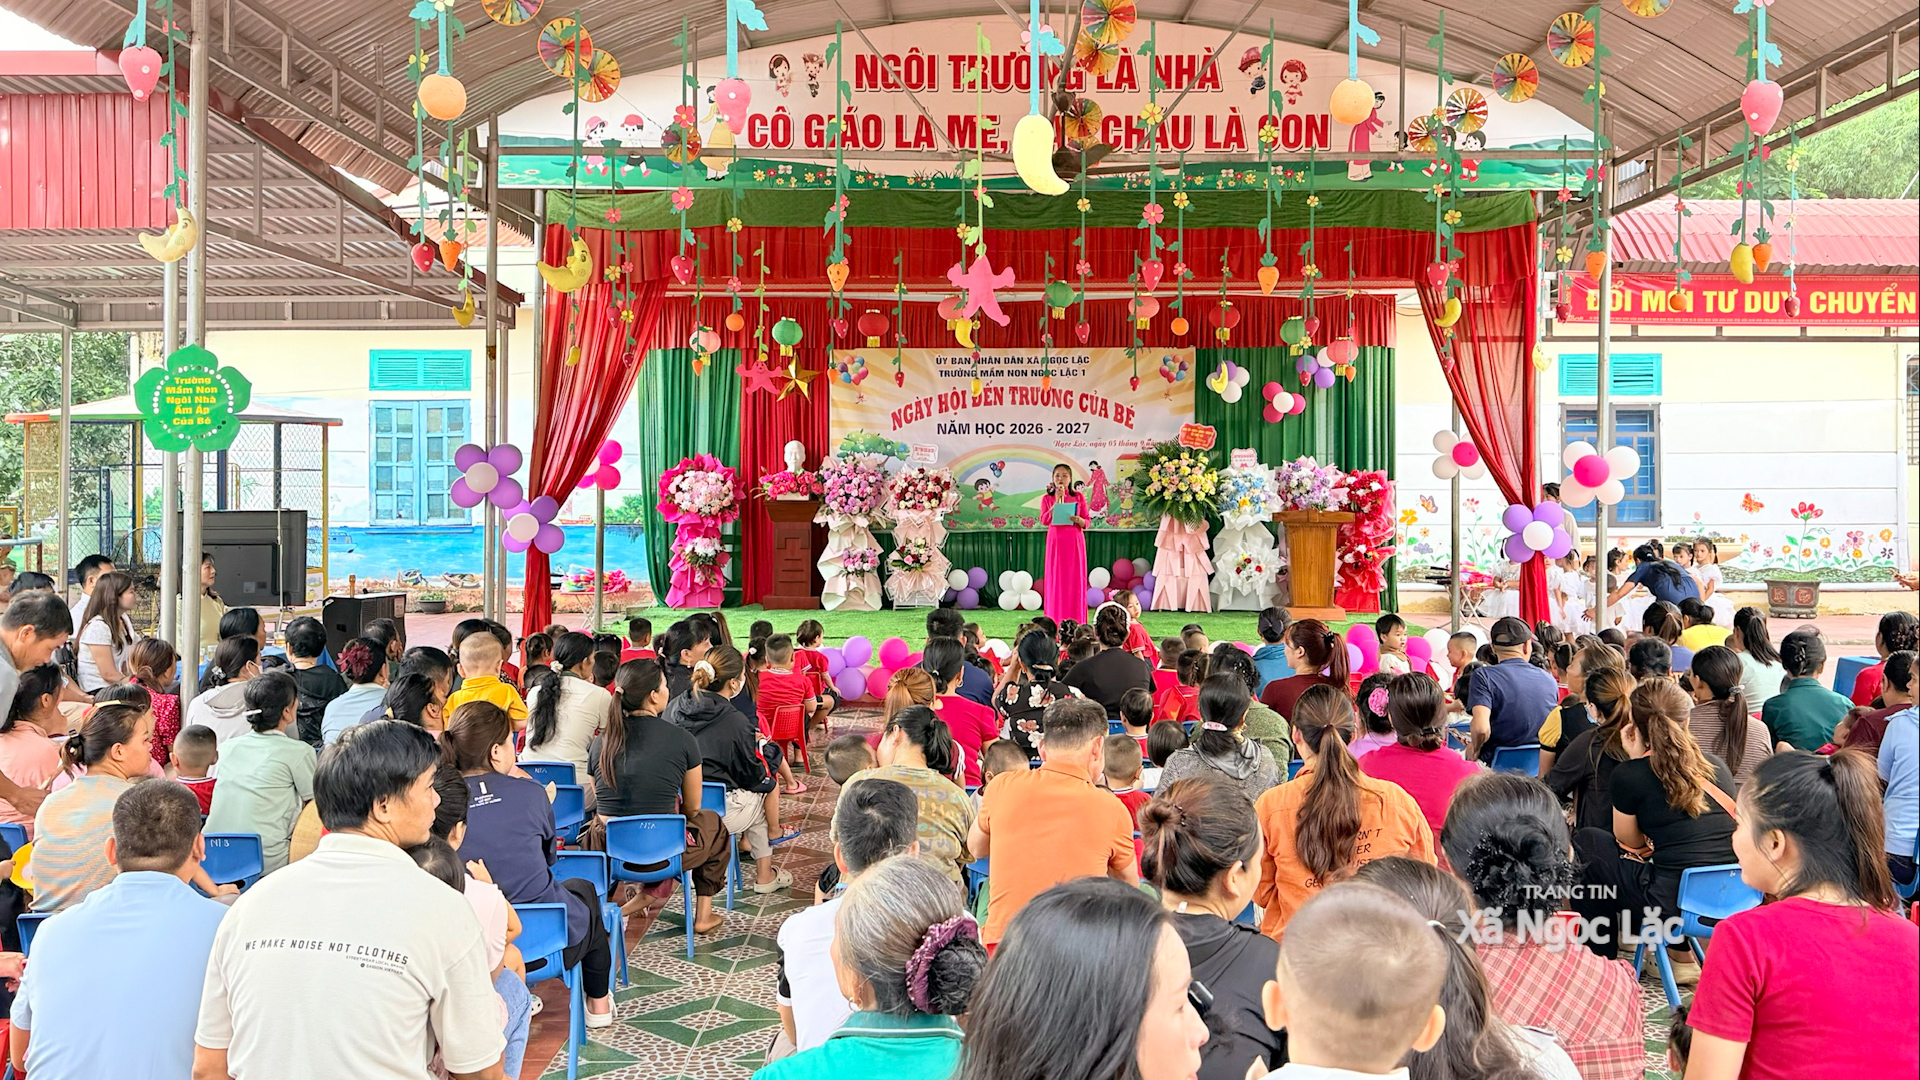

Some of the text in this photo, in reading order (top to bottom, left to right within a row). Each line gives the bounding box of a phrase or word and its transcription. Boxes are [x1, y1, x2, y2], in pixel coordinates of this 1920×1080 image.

[854, 46, 938, 91] NGÔI
[1150, 46, 1222, 91] NHÀ
[747, 105, 793, 149] CÔ
[1204, 106, 1246, 150] LÀ
[1641, 286, 1694, 313] MI
[1702, 288, 1739, 313] TƯ
[1809, 282, 1917, 314] CHUYỂN
[951, 357, 971, 365] BAN
[1004, 355, 1024, 365] DÂN
[1041, 356, 1069, 366] GỌC
[196, 386, 218, 394] Non
[891, 396, 933, 431] NGÀY
[937, 386, 968, 416] HỘI
[1079, 390, 1109, 419] CỦA
[1113, 402, 1136, 430] BÉ
[937, 420, 971, 435] NĂM
[975, 423, 1005, 438] HỌC
[1009, 423, 1044, 434] 2026
[1056, 423, 1090, 434] 2027
[245, 939, 409, 965] WE MAKE NOISE NOT CLOTHES
